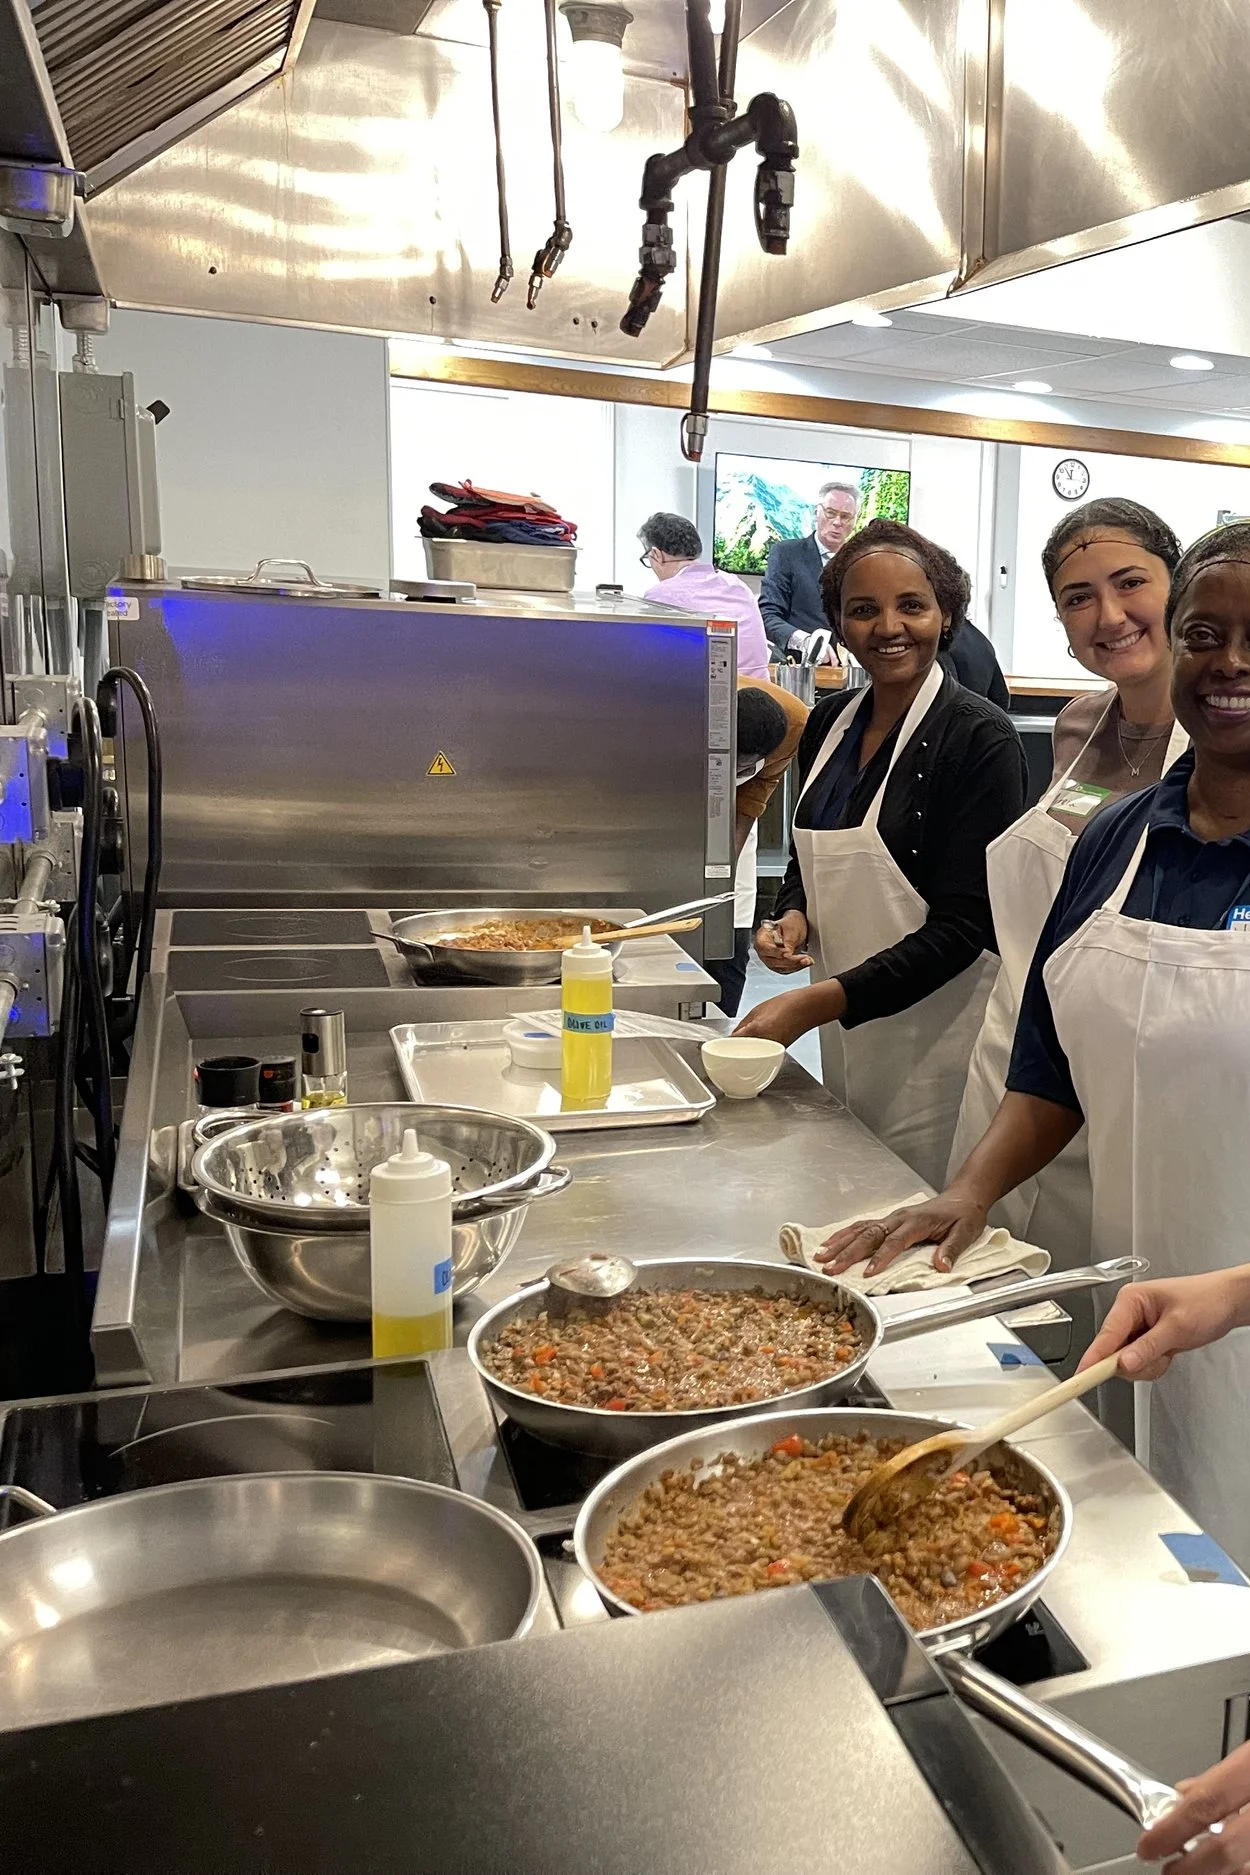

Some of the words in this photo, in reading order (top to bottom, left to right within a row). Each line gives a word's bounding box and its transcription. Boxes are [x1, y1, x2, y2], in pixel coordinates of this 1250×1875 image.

[106, 601, 132, 609] actory
[567, 1016, 592, 1030] OLIVE
[594, 1020, 608, 1029] OIL
